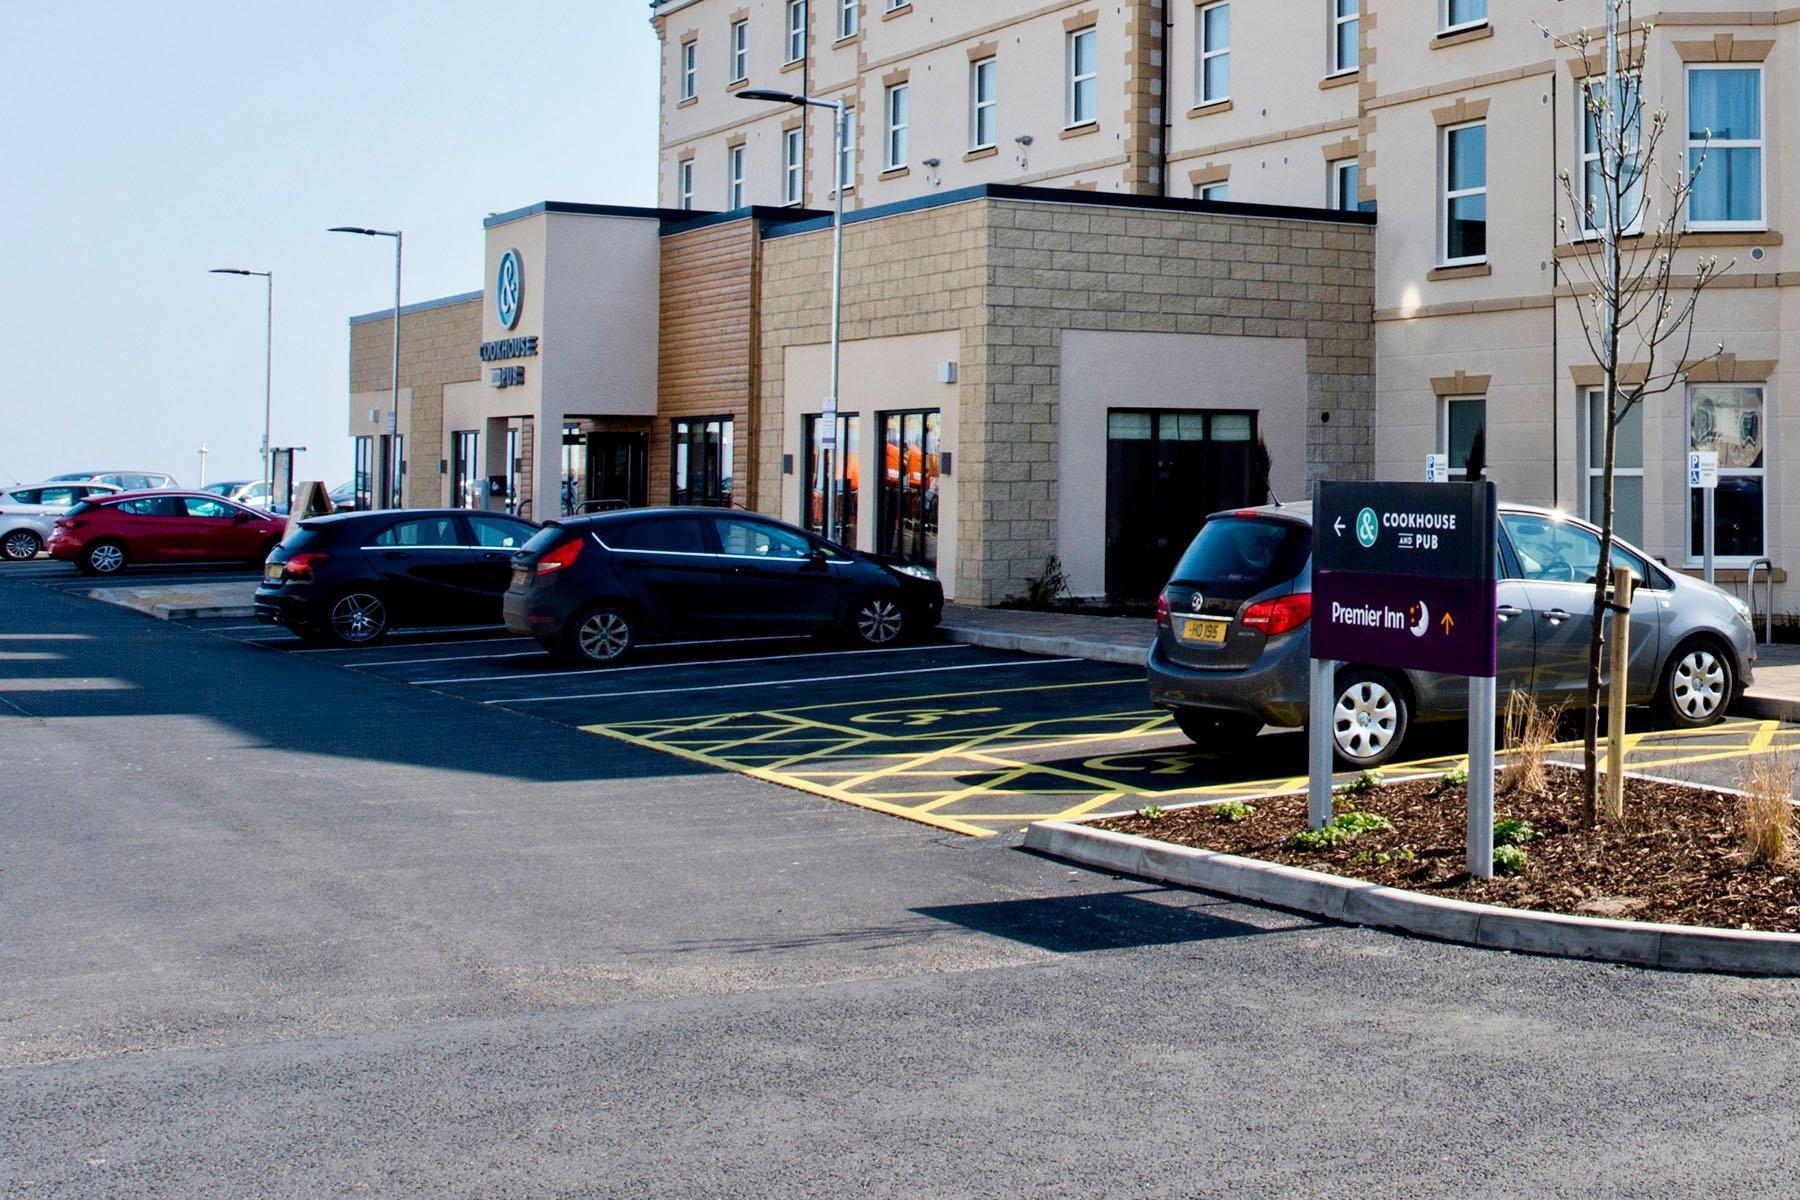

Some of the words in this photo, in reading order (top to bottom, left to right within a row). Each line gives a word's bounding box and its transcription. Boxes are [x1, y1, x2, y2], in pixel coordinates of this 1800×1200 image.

[1383, 513, 1456, 530] COOKHOUSE
[1399, 536, 1413, 545] AND
[1416, 534, 1438, 550] PUB
[1332, 602, 1382, 628] Premier
[1384, 606, 1405, 630] Inn
